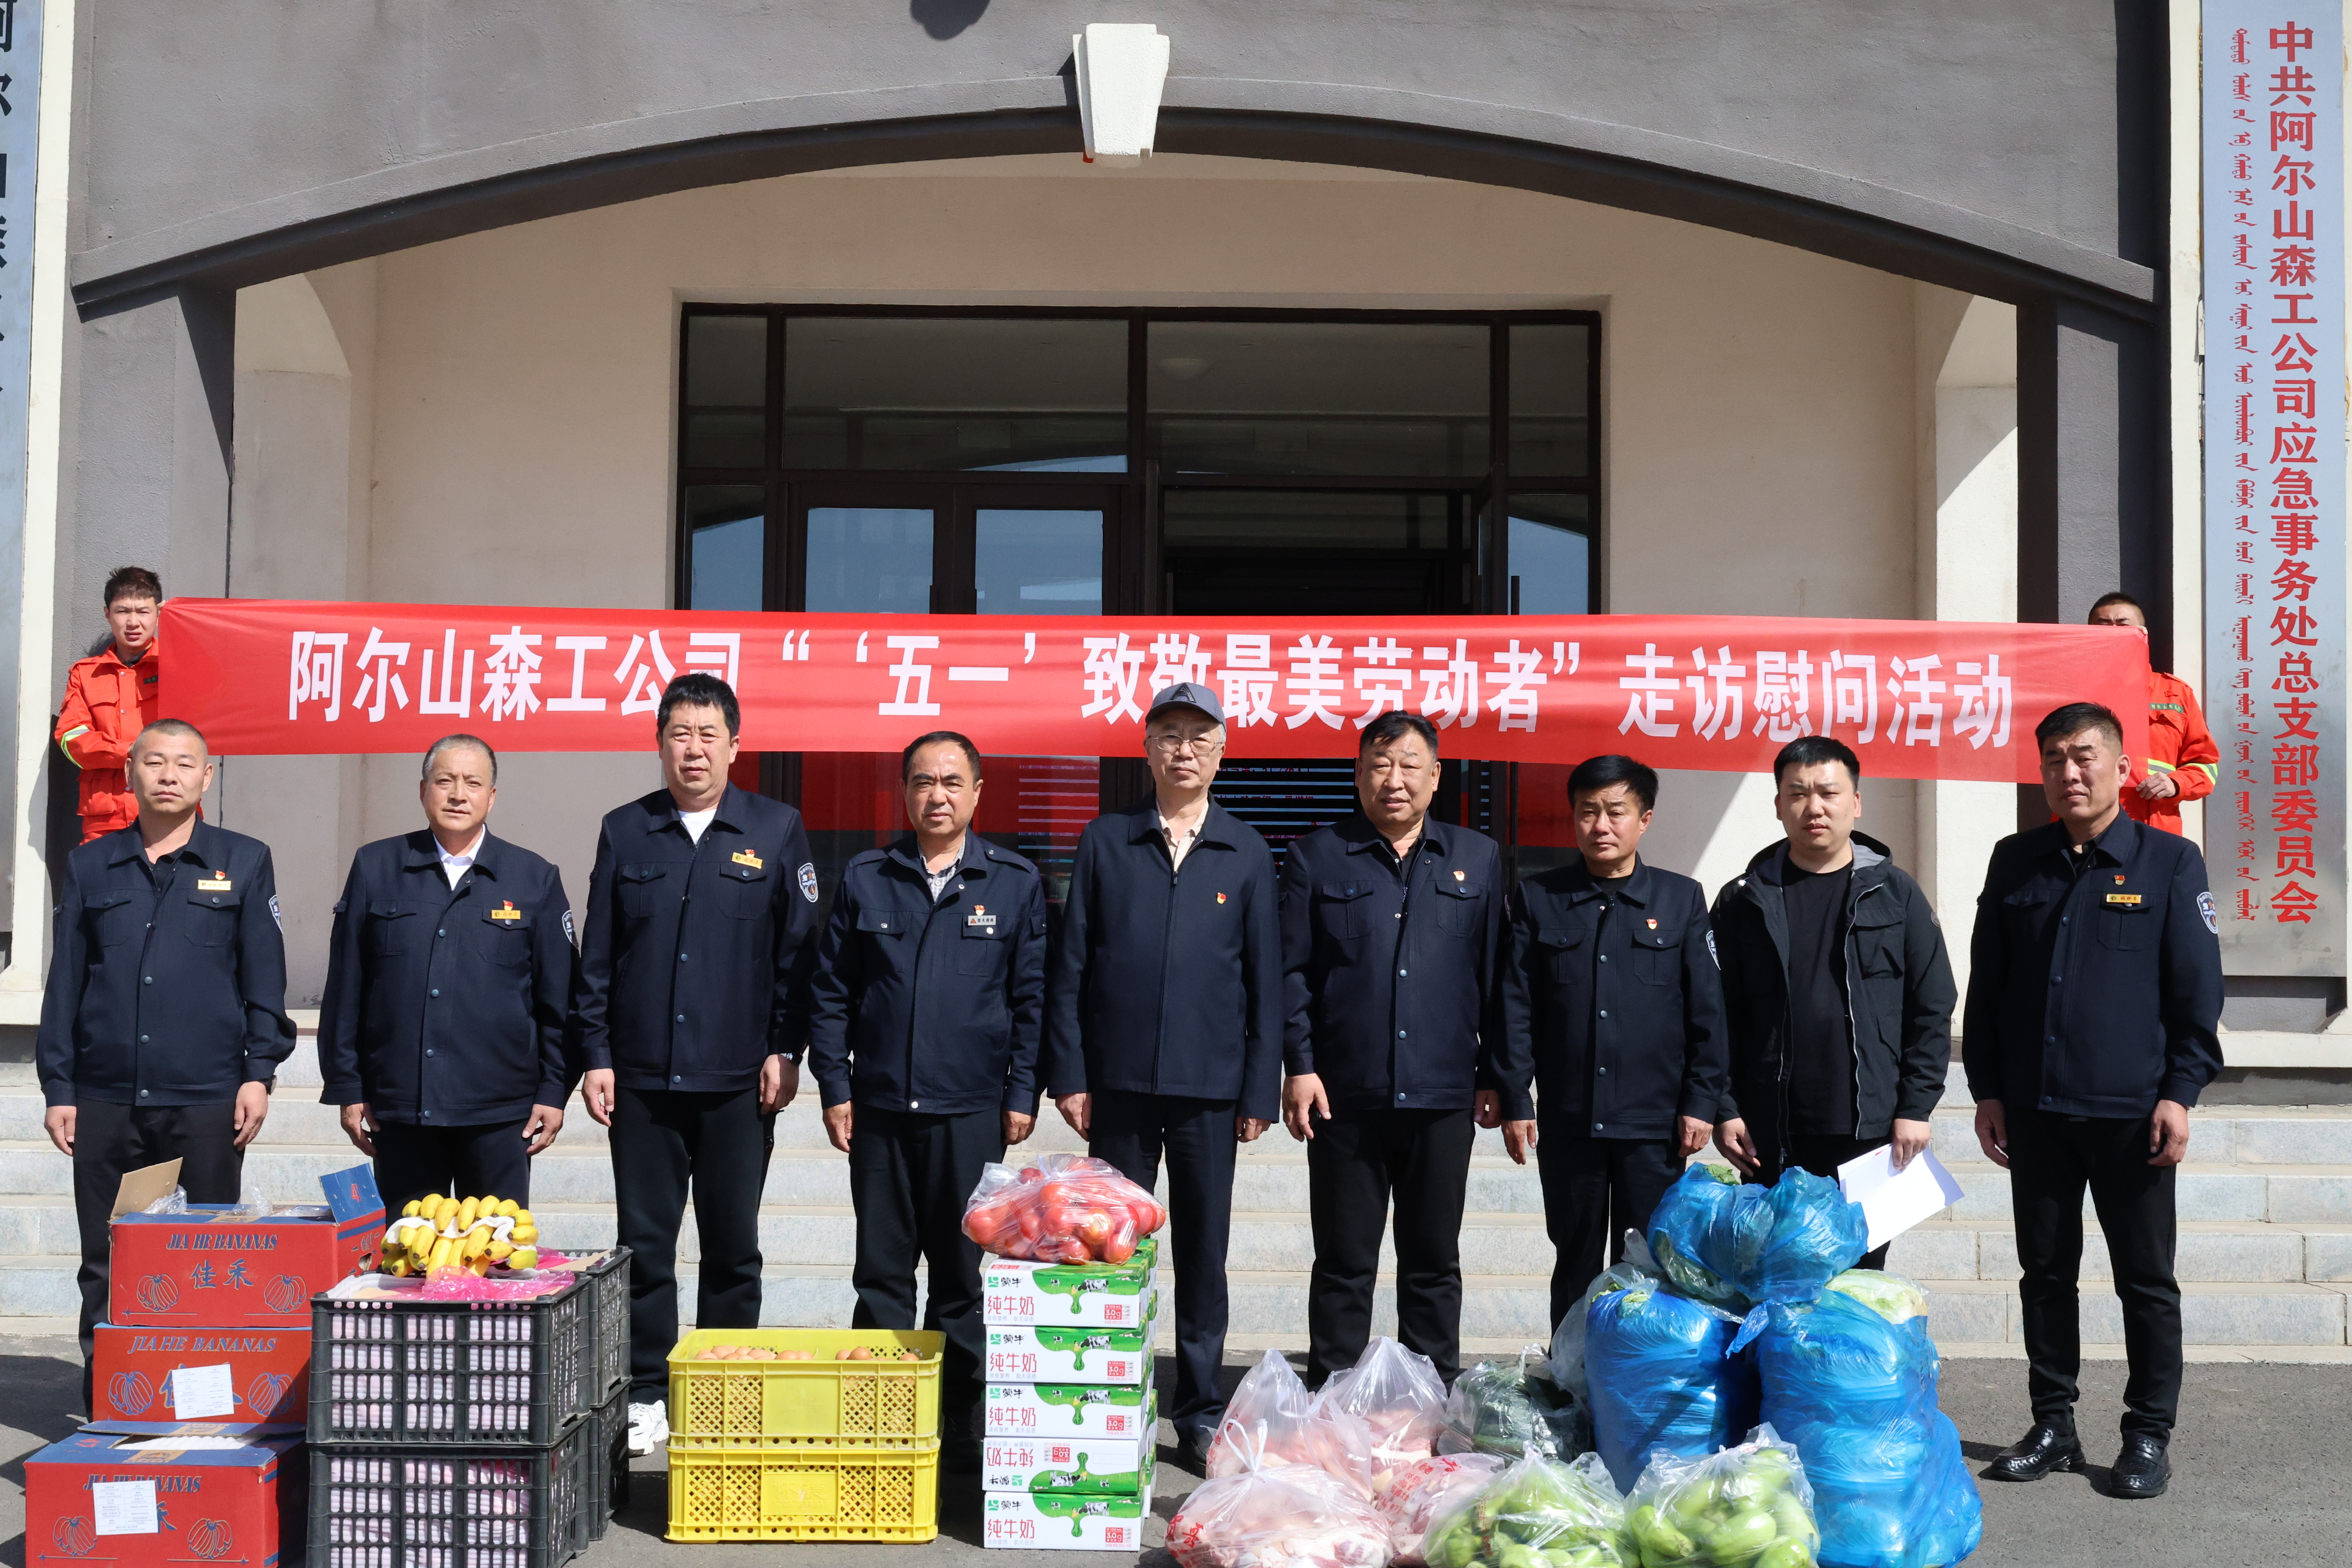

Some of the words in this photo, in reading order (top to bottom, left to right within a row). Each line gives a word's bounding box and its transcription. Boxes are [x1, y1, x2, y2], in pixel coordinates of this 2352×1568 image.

[2269, 21, 2321, 924] 中共阿尔山森工公司应急事务处总支部委员会
[166, 1234, 189, 1250] JIA
[191, 1234, 214, 1250] HE
[213, 1234, 278, 1250] BANANAS
[190, 1258, 254, 1290] 佳禾
[1001, 1277, 1022, 1288] 蒙牛
[987, 1295, 1034, 1316] 纯牛奶
[127, 1336, 157, 1354] JIA
[158, 1336, 188, 1351] HE
[191, 1337, 278, 1352] BANANAS
[1003, 1334, 1024, 1345] 蒙牛
[990, 1353, 1037, 1372] 纯牛奶
[1003, 1388, 1024, 1399] 蒙牛
[989, 1406, 1036, 1426] 纯牛奶
[987, 1447, 1033, 1467] 纯牛奶
[989, 1474, 1009, 1485] 蒙牛
[1001, 1500, 1022, 1511] 蒙牛
[987, 1519, 1034, 1539] 纯牛奶
